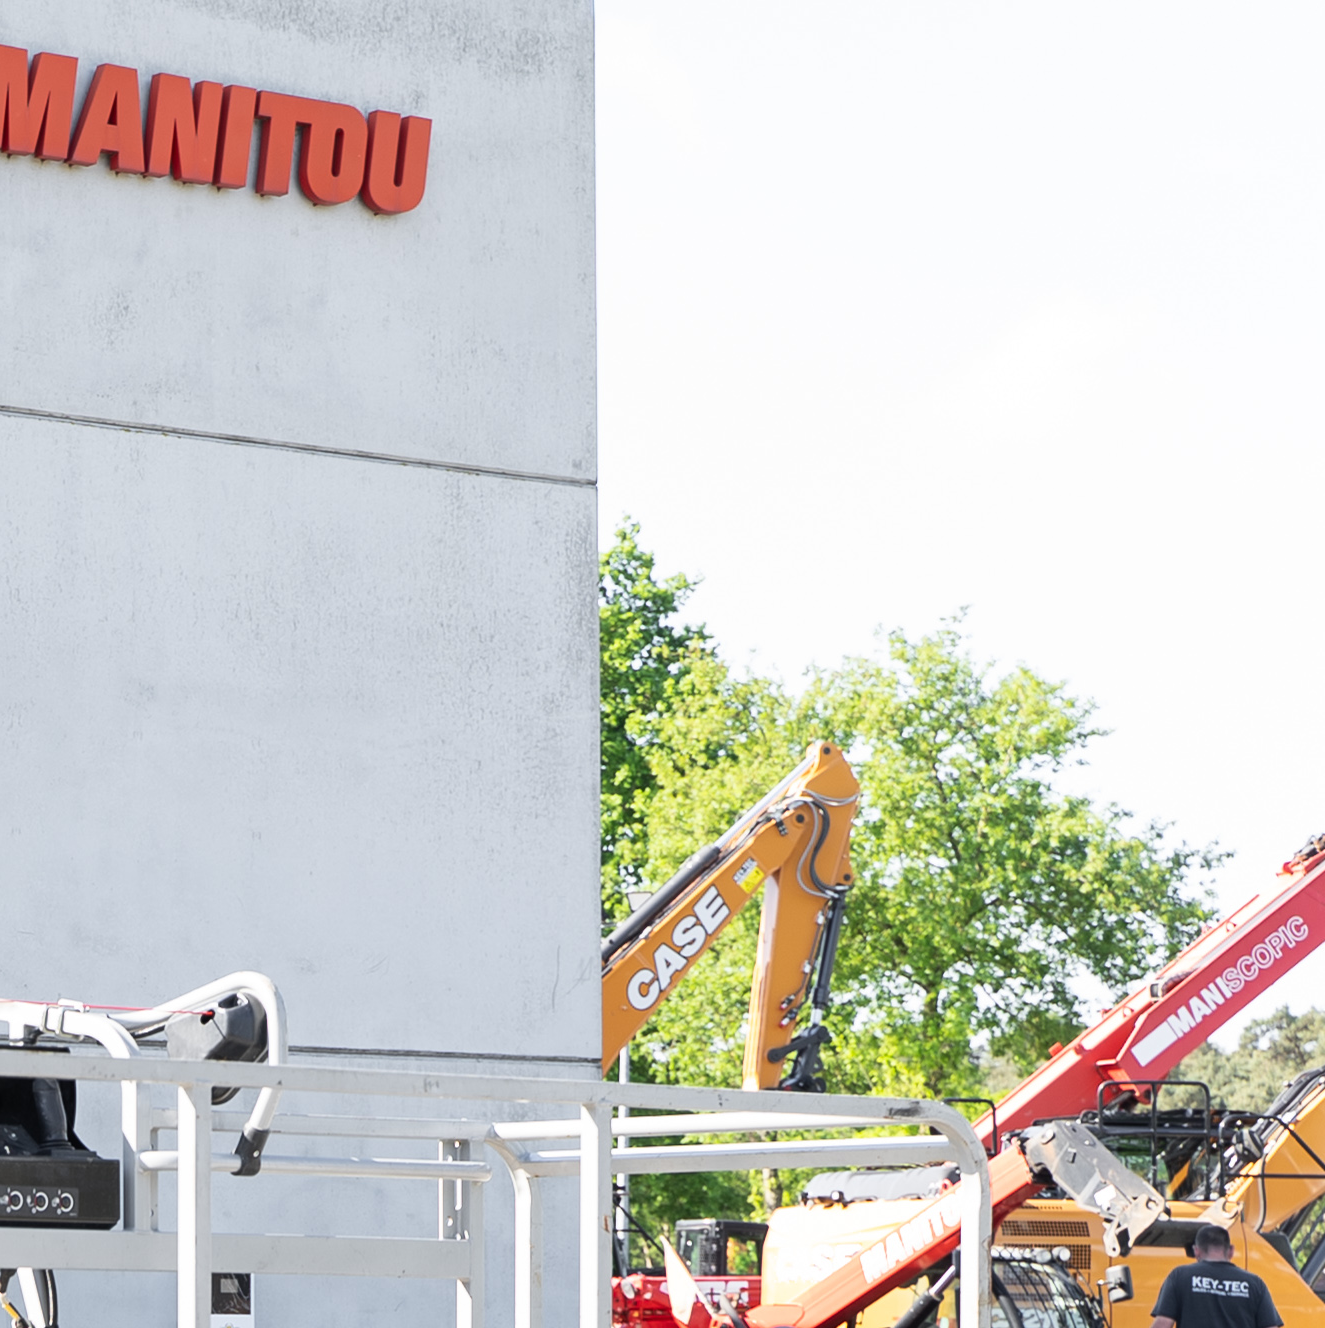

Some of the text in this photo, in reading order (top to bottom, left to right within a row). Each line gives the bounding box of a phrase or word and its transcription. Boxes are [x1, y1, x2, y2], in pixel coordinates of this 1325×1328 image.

[627, 884, 731, 1011] CASE
[1166, 915, 1309, 1038] MANISCOPIC
[1192, 1276, 1249, 1293] KEY-TEC
